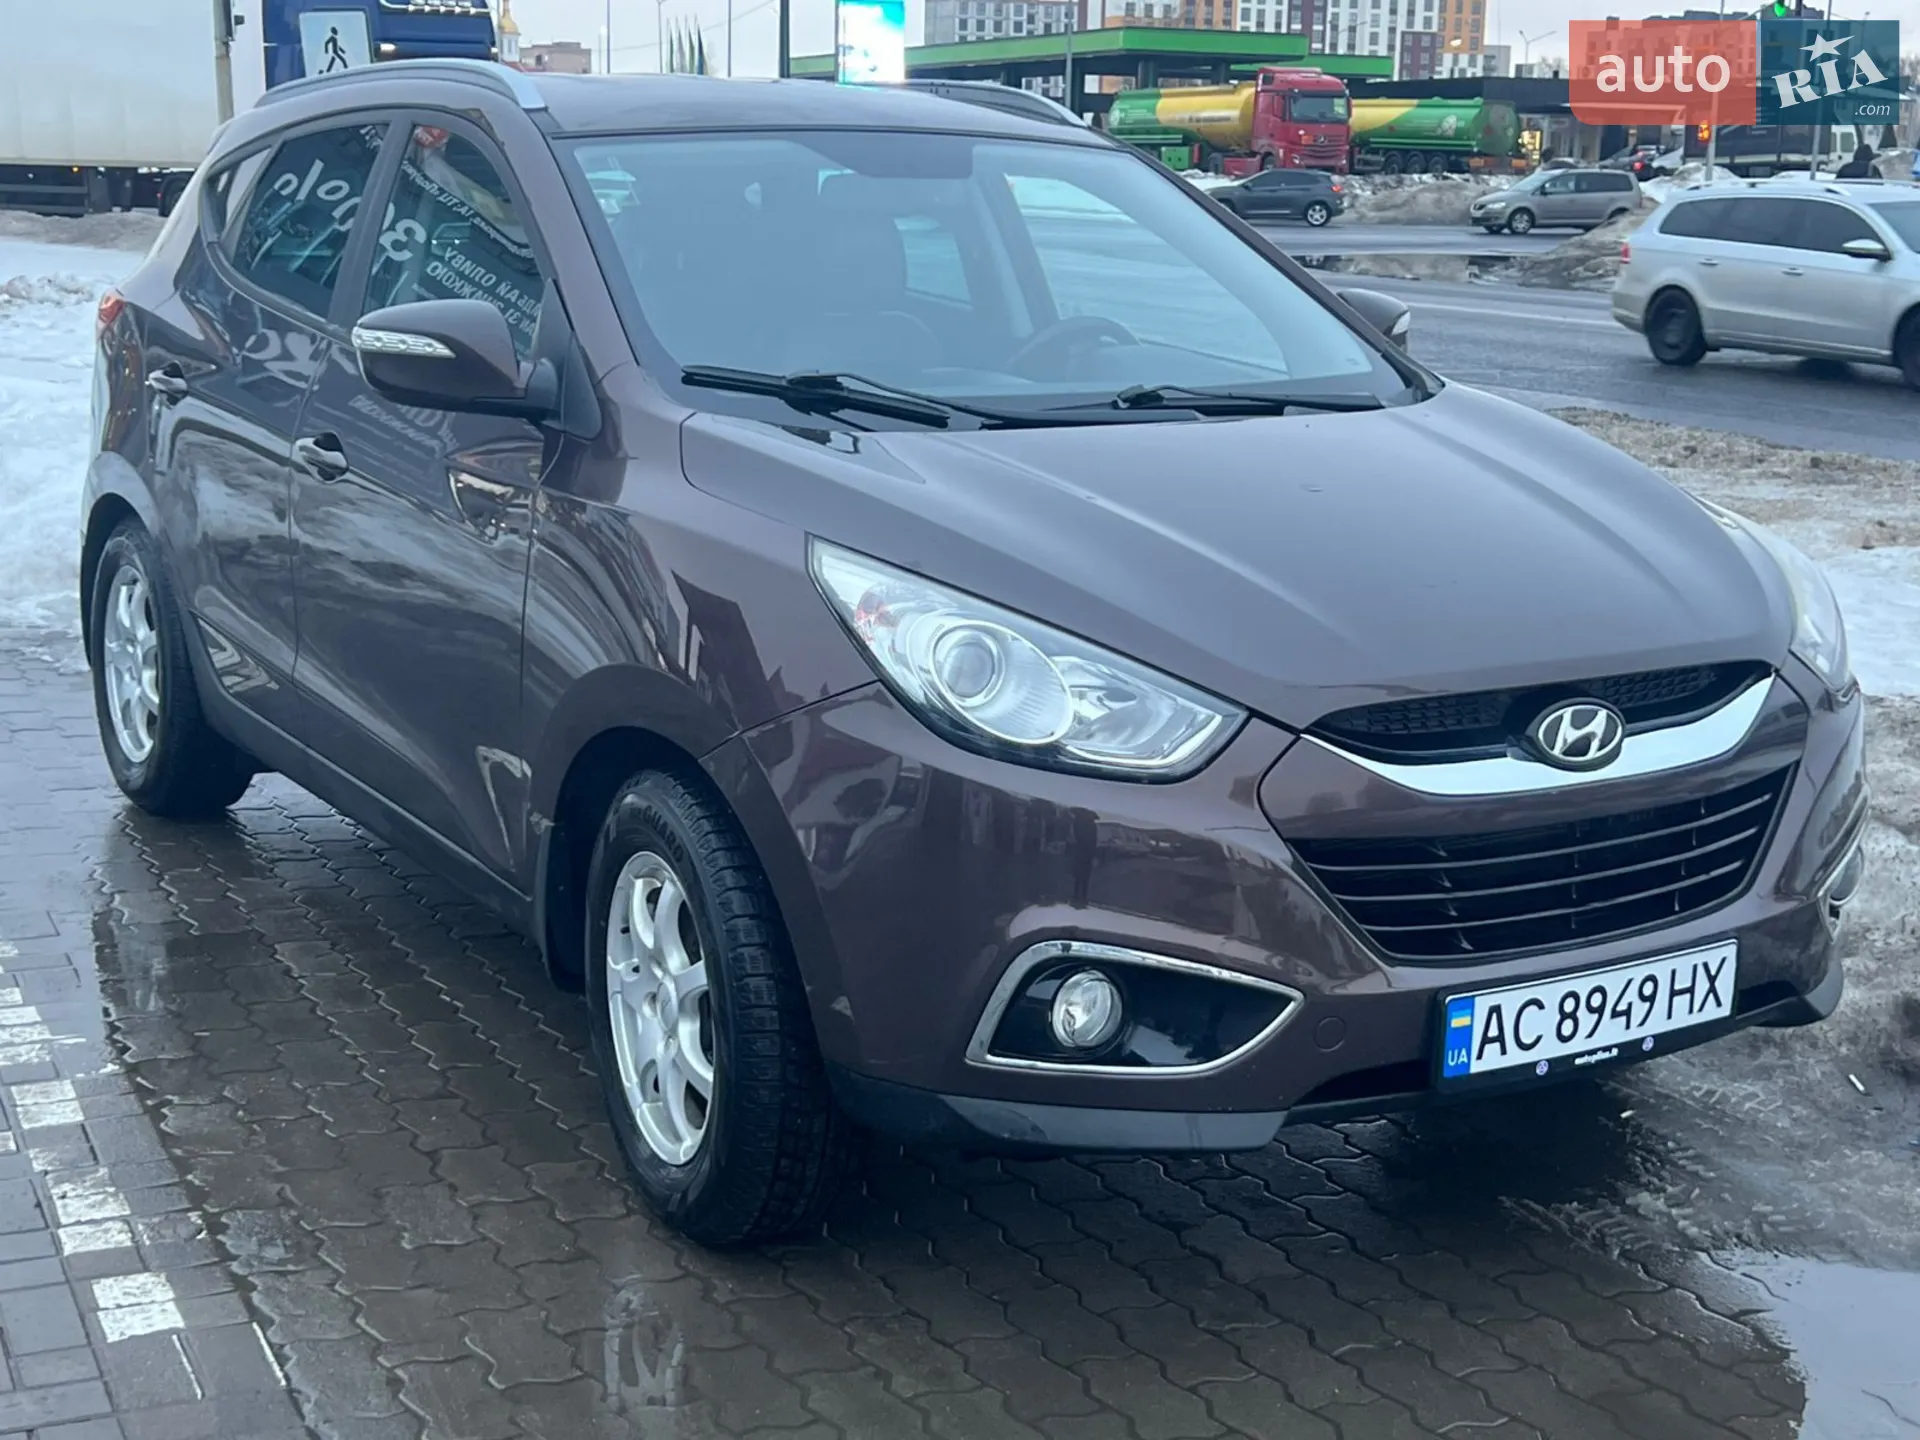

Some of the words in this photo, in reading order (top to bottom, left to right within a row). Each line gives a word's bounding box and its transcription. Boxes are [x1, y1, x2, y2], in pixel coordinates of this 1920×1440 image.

[1475, 998, 1546, 1061] AC
[1555, 973, 1660, 1044] 8949
[1666, 957, 1728, 1021] HX
[1447, 1049, 1468, 1066] UA
